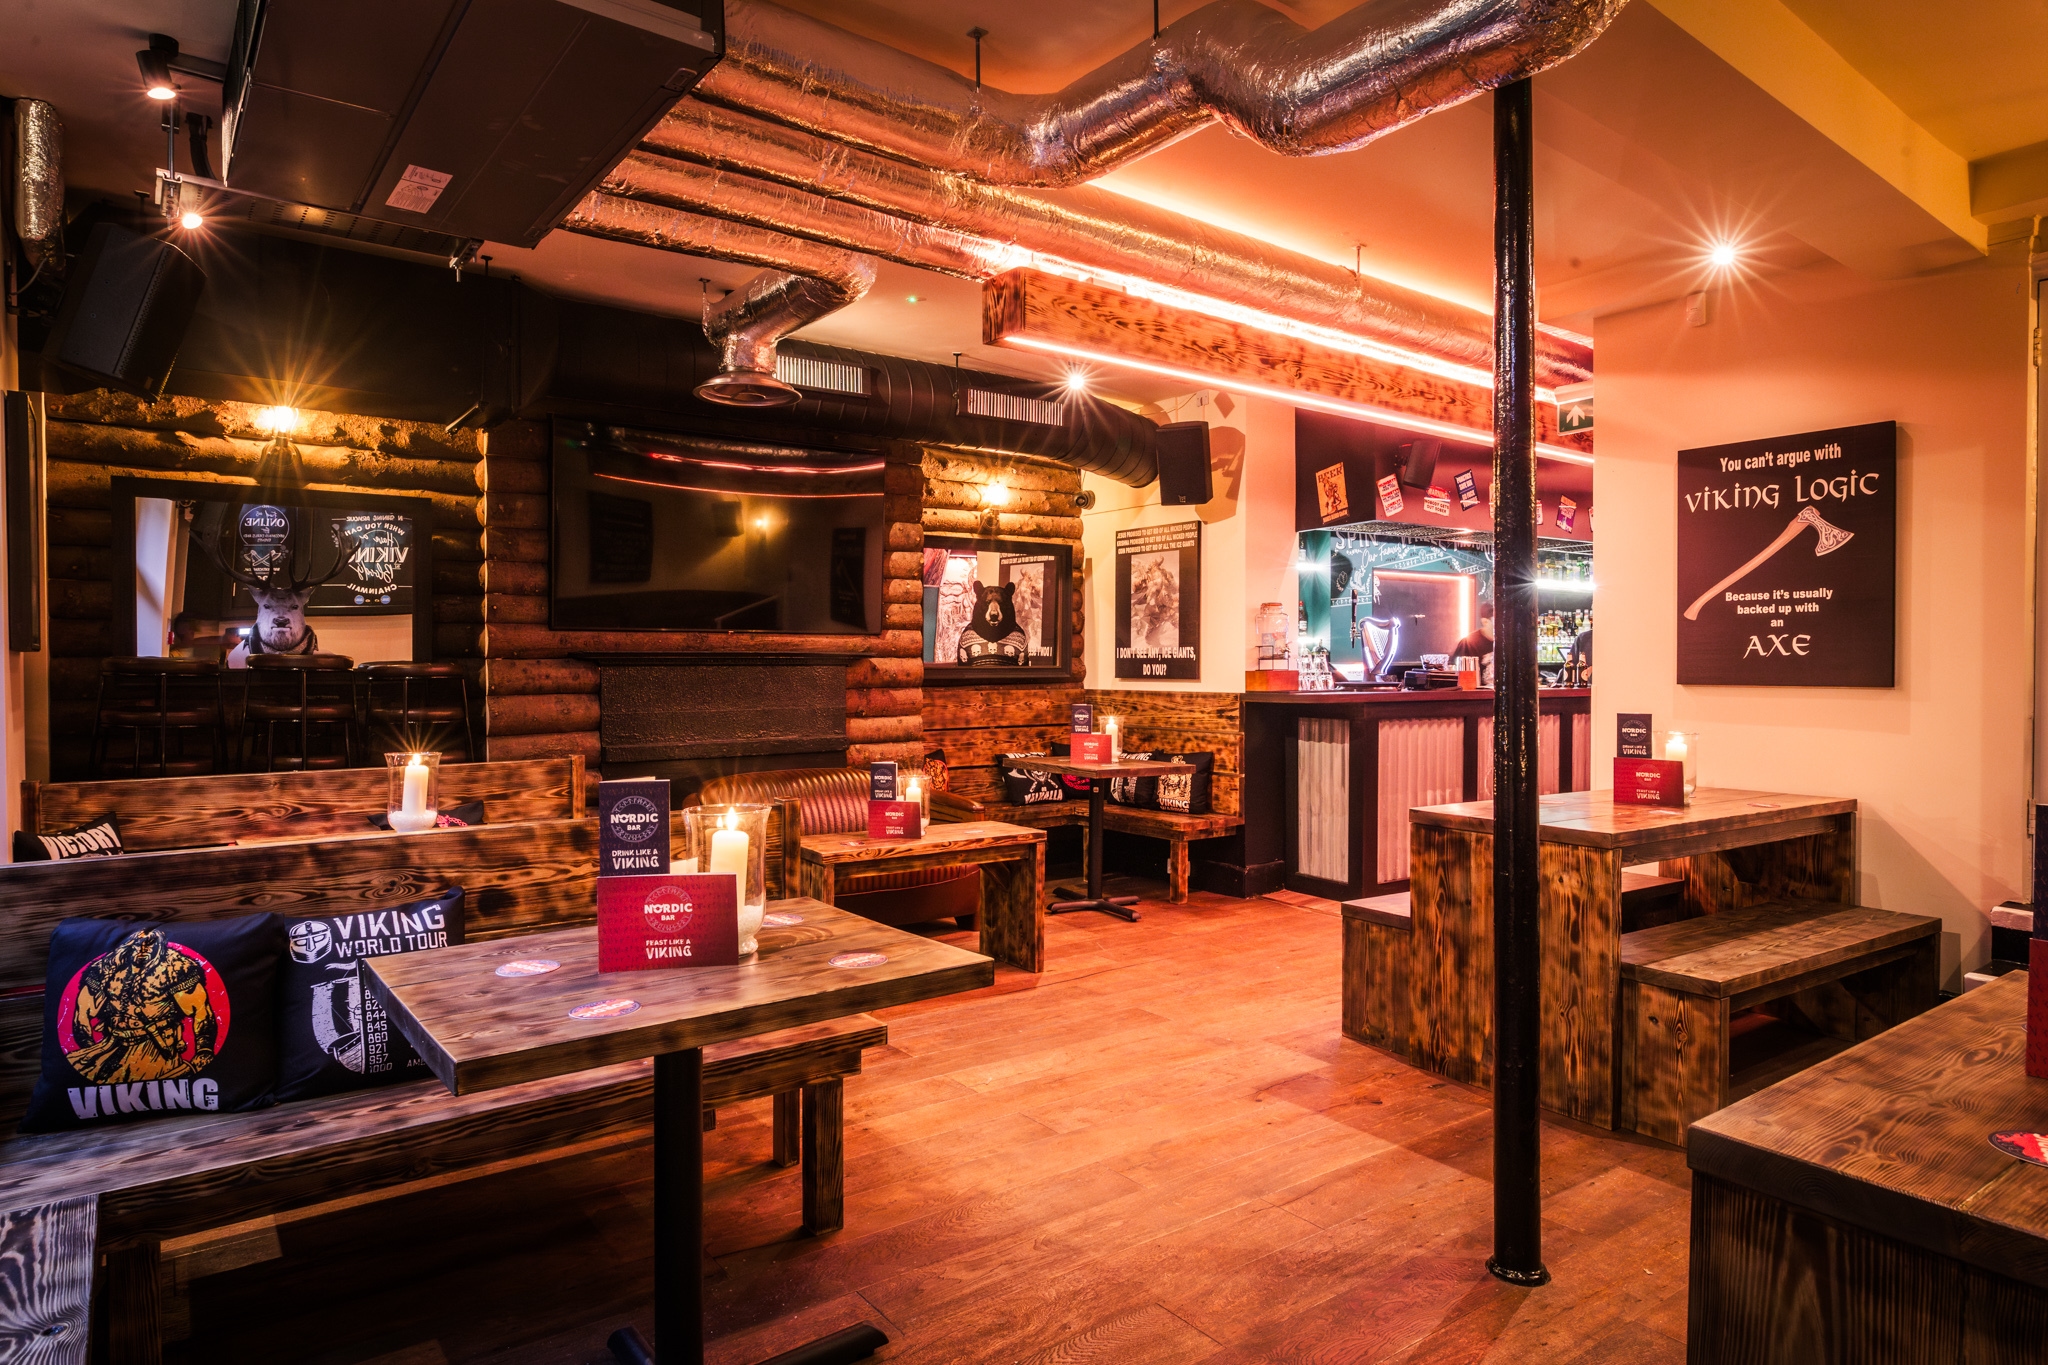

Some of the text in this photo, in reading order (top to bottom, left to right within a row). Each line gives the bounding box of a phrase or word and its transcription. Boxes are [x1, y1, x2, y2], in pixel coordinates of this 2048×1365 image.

[1720, 443, 1842, 472] You can't argue with
[1318, 466, 1342, 484] BEER
[1726, 588, 1833, 602] Because it's usually
[1737, 602, 1819, 615] backed up with
[1743, 634, 1811, 659] AXE
[1120, 648, 1135, 658] DON'T
[1137, 648, 1147, 658] SEE
[1162, 647, 1172, 658] ICE
[1173, 647, 1196, 661] GIANTS,
[1143, 664, 1167, 675] DO YOU?
[1024, 789, 1063, 804] VALHALLA
[1159, 798, 1189, 809] VIKING
[610, 813, 659, 824] NORDIC
[38, 823, 121, 860] VICTORY
[613, 856, 659, 870] VIKING
[644, 903, 693, 914] NORDIC
[333, 904, 445, 940] VIKING
[335, 931, 448, 958] WORLD TOUR
[646, 945, 692, 960] VIKING
[366, 1010, 387, 1022] 844
[367, 1021, 387, 1032] 845
[368, 1032, 388, 1043] 860
[369, 1043, 386, 1054] 921
[370, 1054, 389, 1065] 957
[370, 1063, 392, 1073] 1000
[67, 1078, 219, 1120] VIKING
